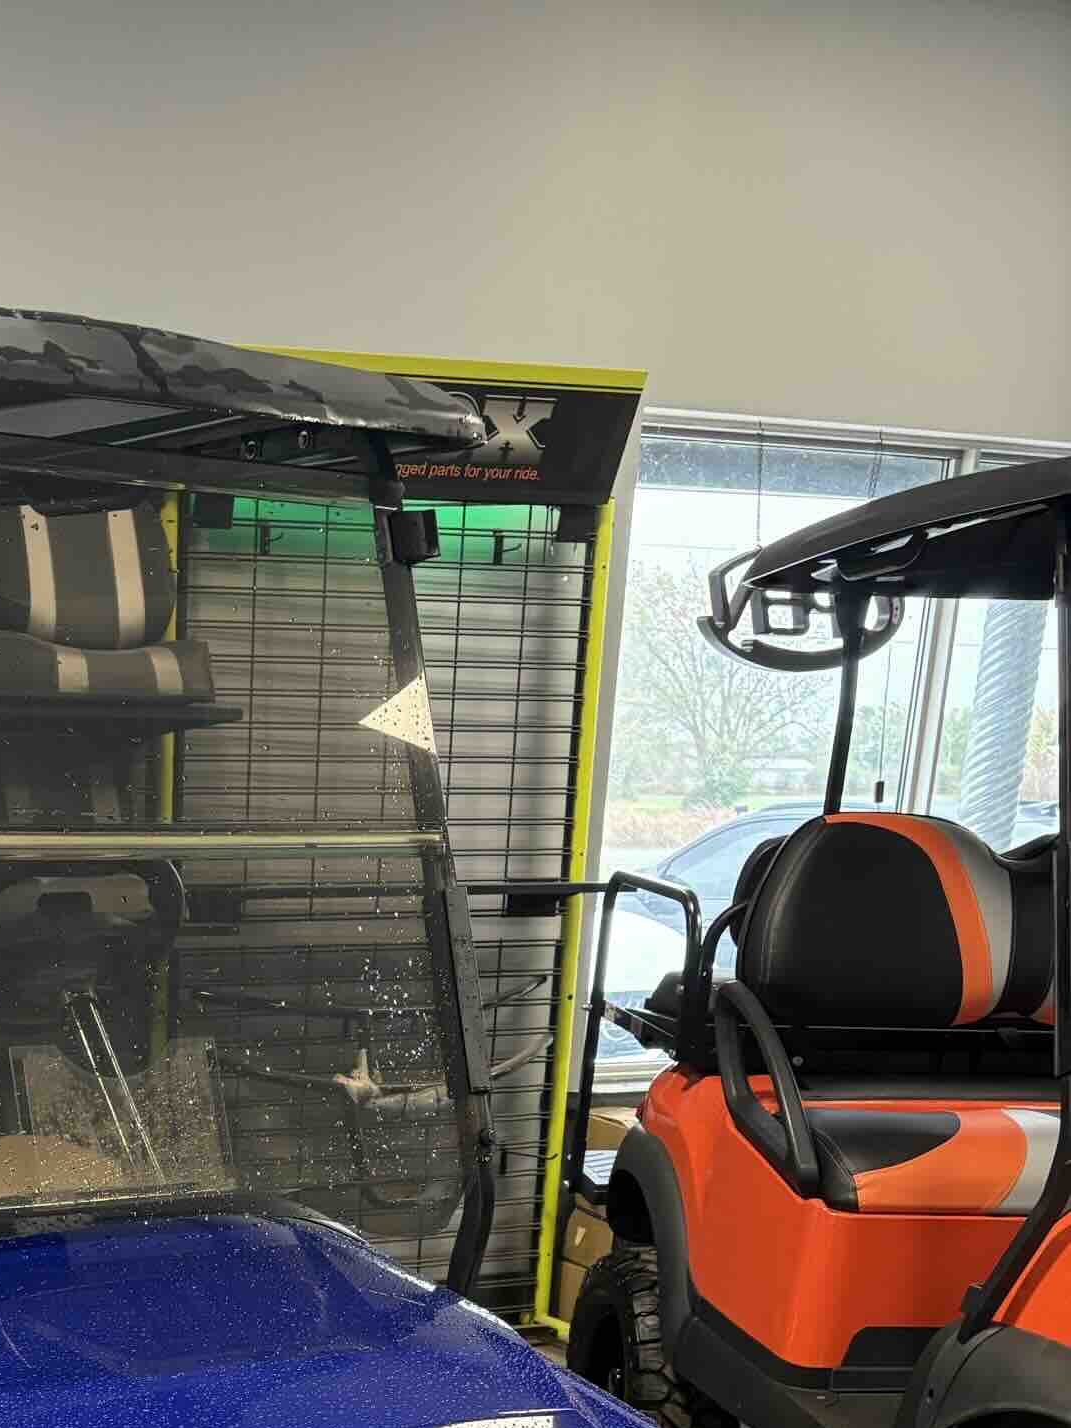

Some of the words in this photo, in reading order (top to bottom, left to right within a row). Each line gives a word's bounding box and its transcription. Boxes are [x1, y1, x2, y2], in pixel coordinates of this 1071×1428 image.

[427, 463, 461, 479] parts
[464, 463, 483, 478] for
[483, 467, 514, 481] your
[514, 464, 541, 480] ride.
